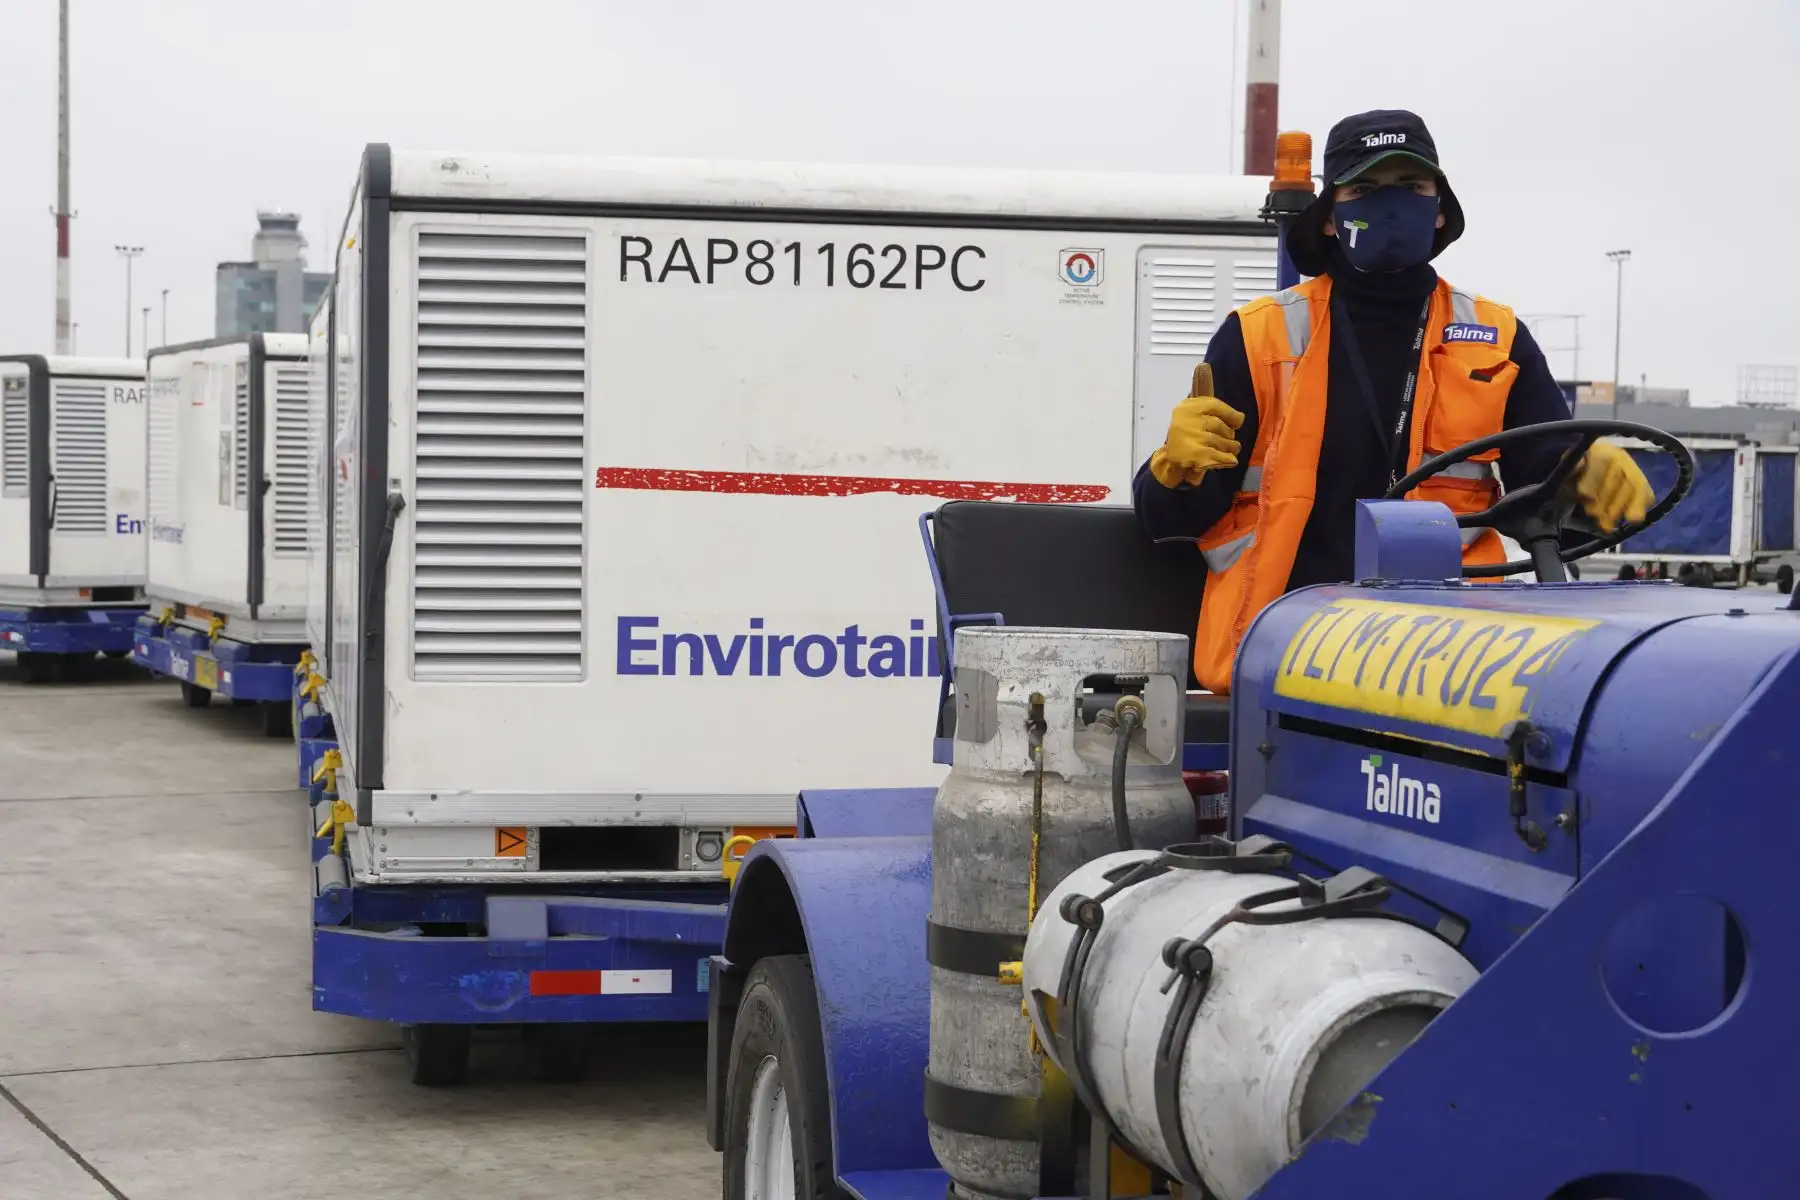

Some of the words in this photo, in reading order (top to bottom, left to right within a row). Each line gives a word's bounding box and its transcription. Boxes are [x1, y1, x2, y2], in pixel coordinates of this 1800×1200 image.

[1361, 132, 1406, 147] Talma
[619, 235, 987, 292] RAP81162PC
[1413, 327, 1424, 350] Talma
[1444, 325, 1494, 341] Talma
[1395, 411, 1407, 435] Talma
[1360, 753, 1441, 824] Talma
